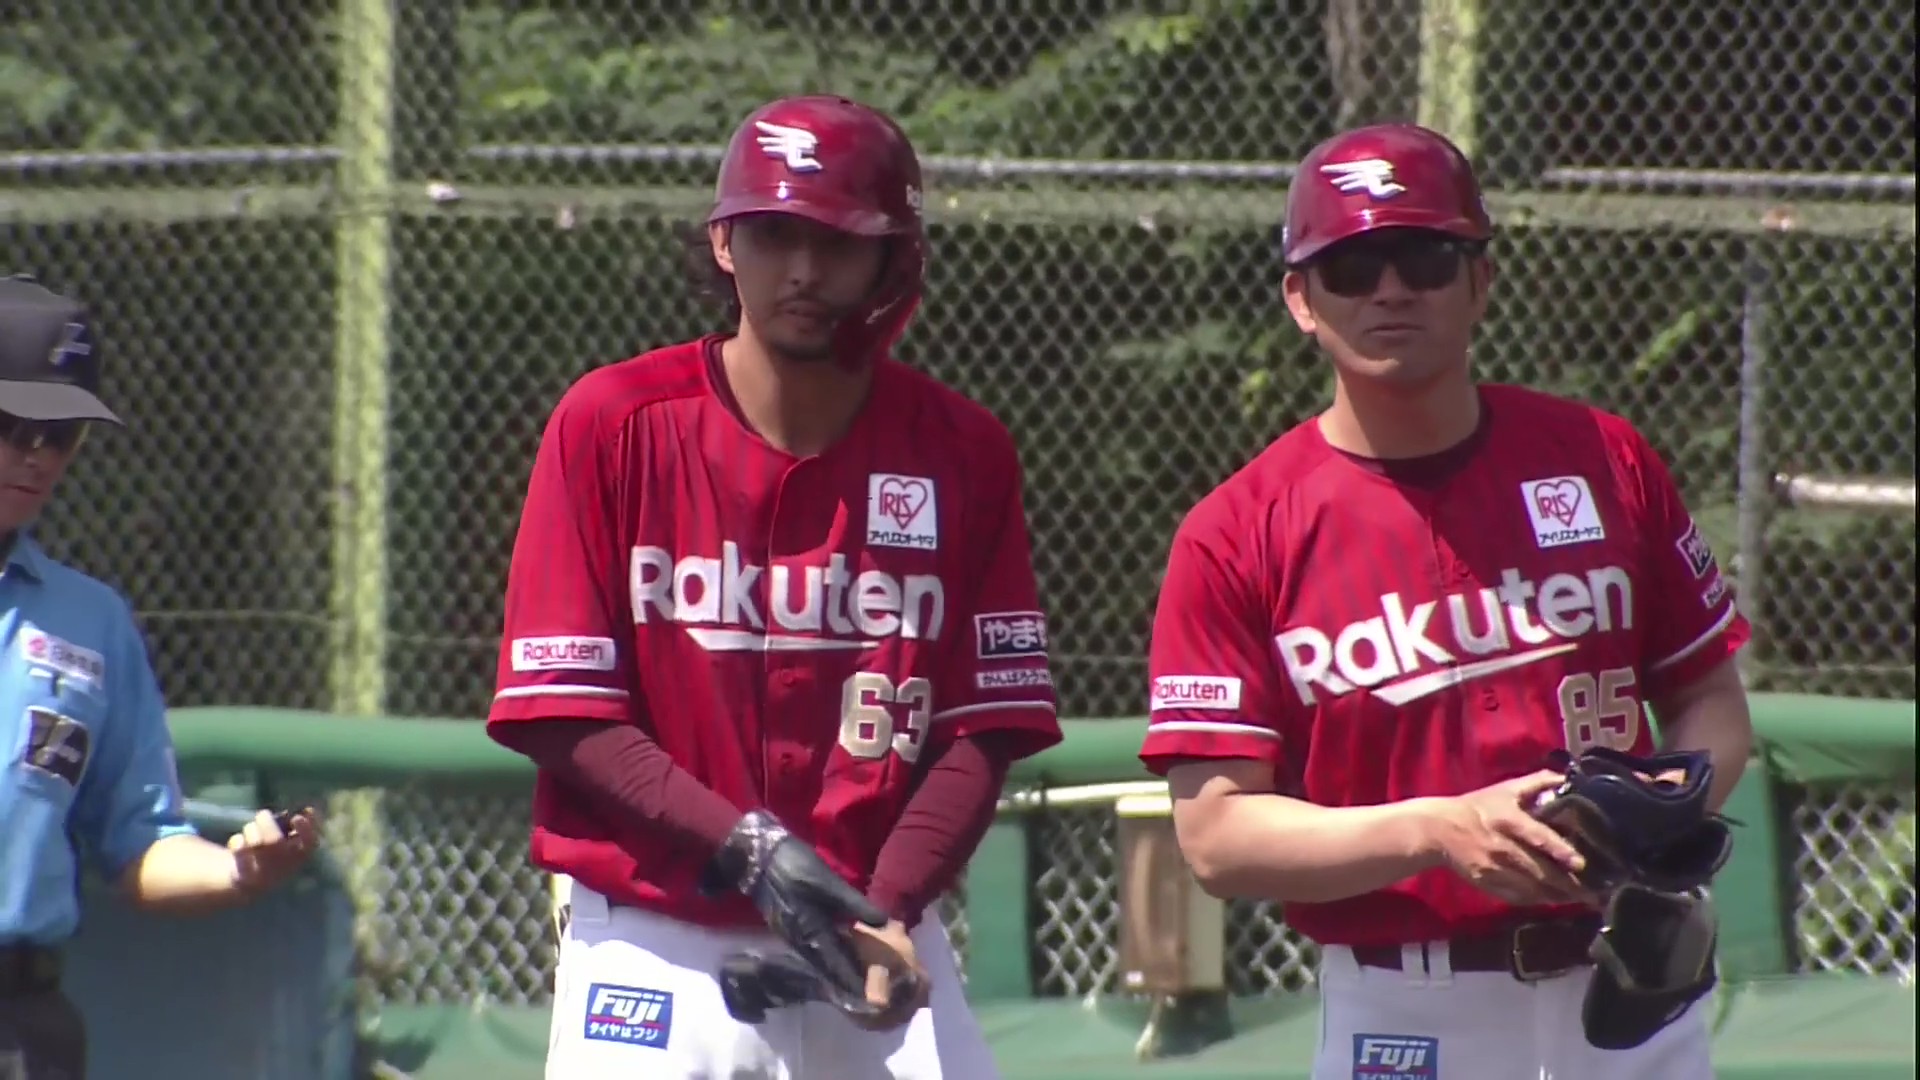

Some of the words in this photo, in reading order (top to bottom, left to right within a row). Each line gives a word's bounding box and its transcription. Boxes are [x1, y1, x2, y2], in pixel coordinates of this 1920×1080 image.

[630, 540, 945, 641] Rakuten
[1274, 564, 1634, 706] Rakuten
[522, 640, 604, 660] Rakuten
[1153, 680, 1228, 700] akuten
[839, 671, 933, 763] 63
[1557, 665, 1639, 757] 85
[589, 1021, 660, 1041] タイヤはフジ
